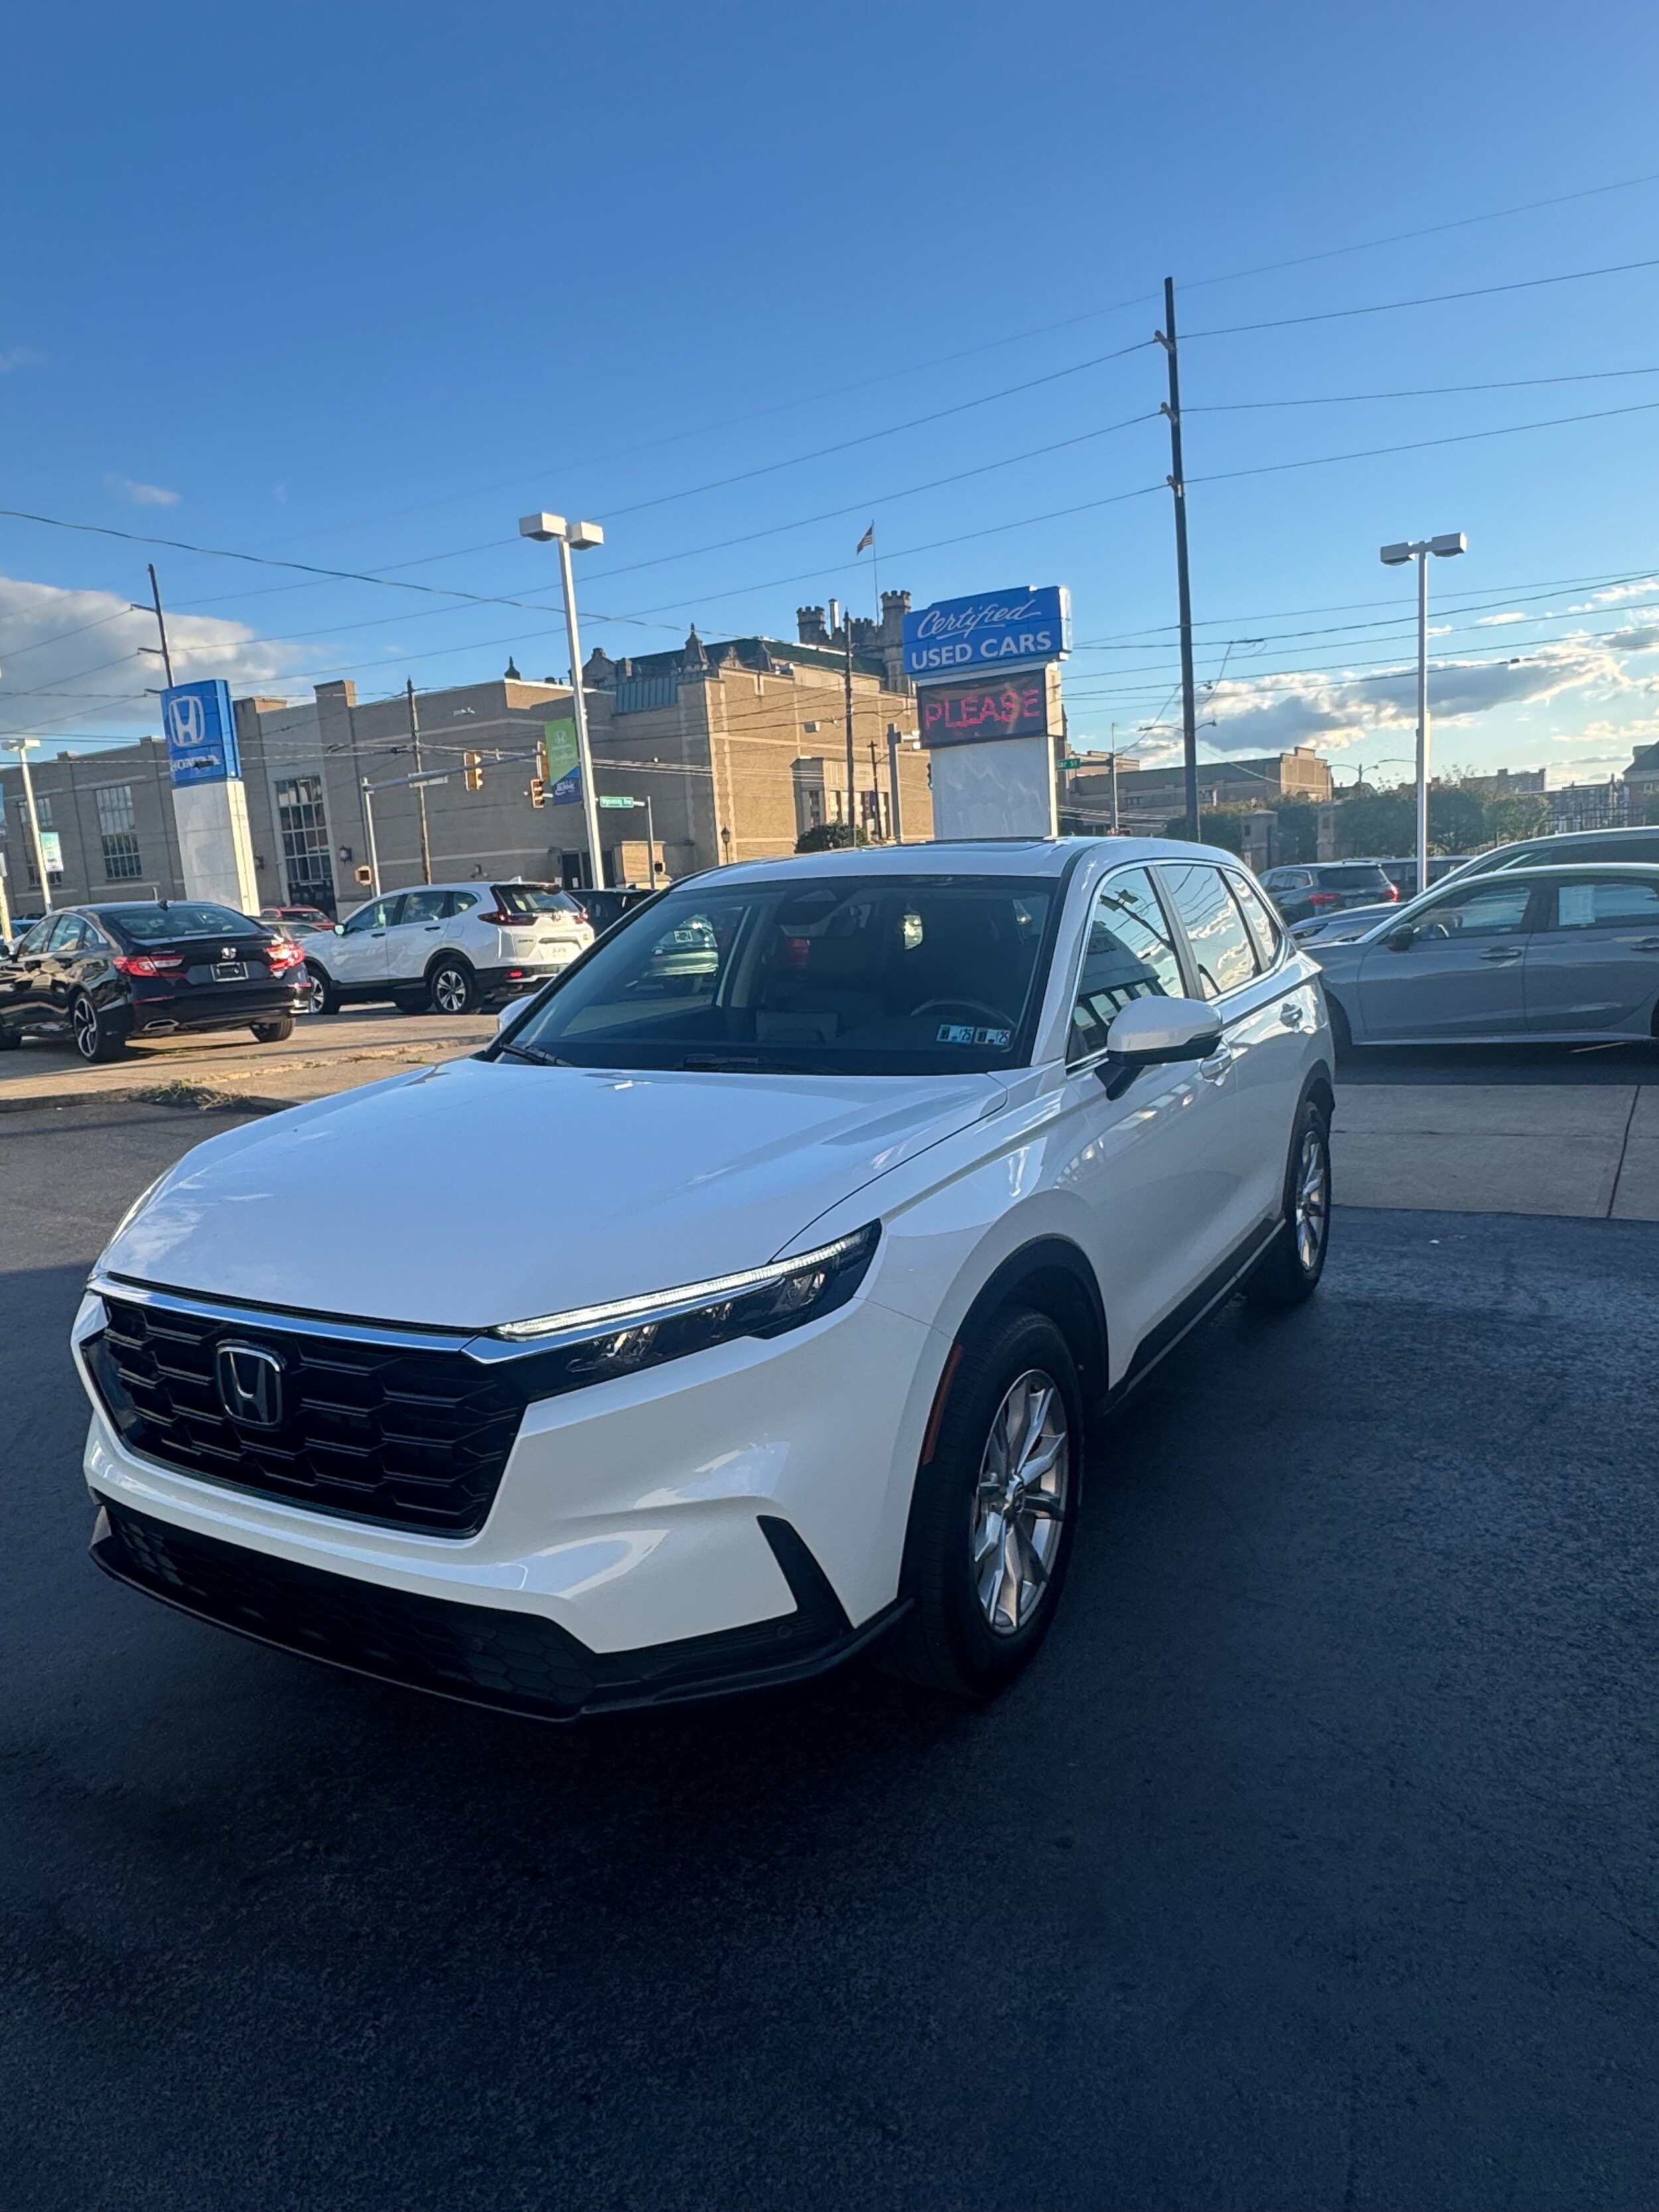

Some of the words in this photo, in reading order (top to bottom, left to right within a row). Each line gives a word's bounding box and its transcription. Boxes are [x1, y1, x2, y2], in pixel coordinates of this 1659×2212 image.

[917, 599, 1041, 639] Certified
[911, 644, 972, 670] USED
[980, 631, 1051, 658] CARS
[924, 688, 1041, 729] PLEASE
